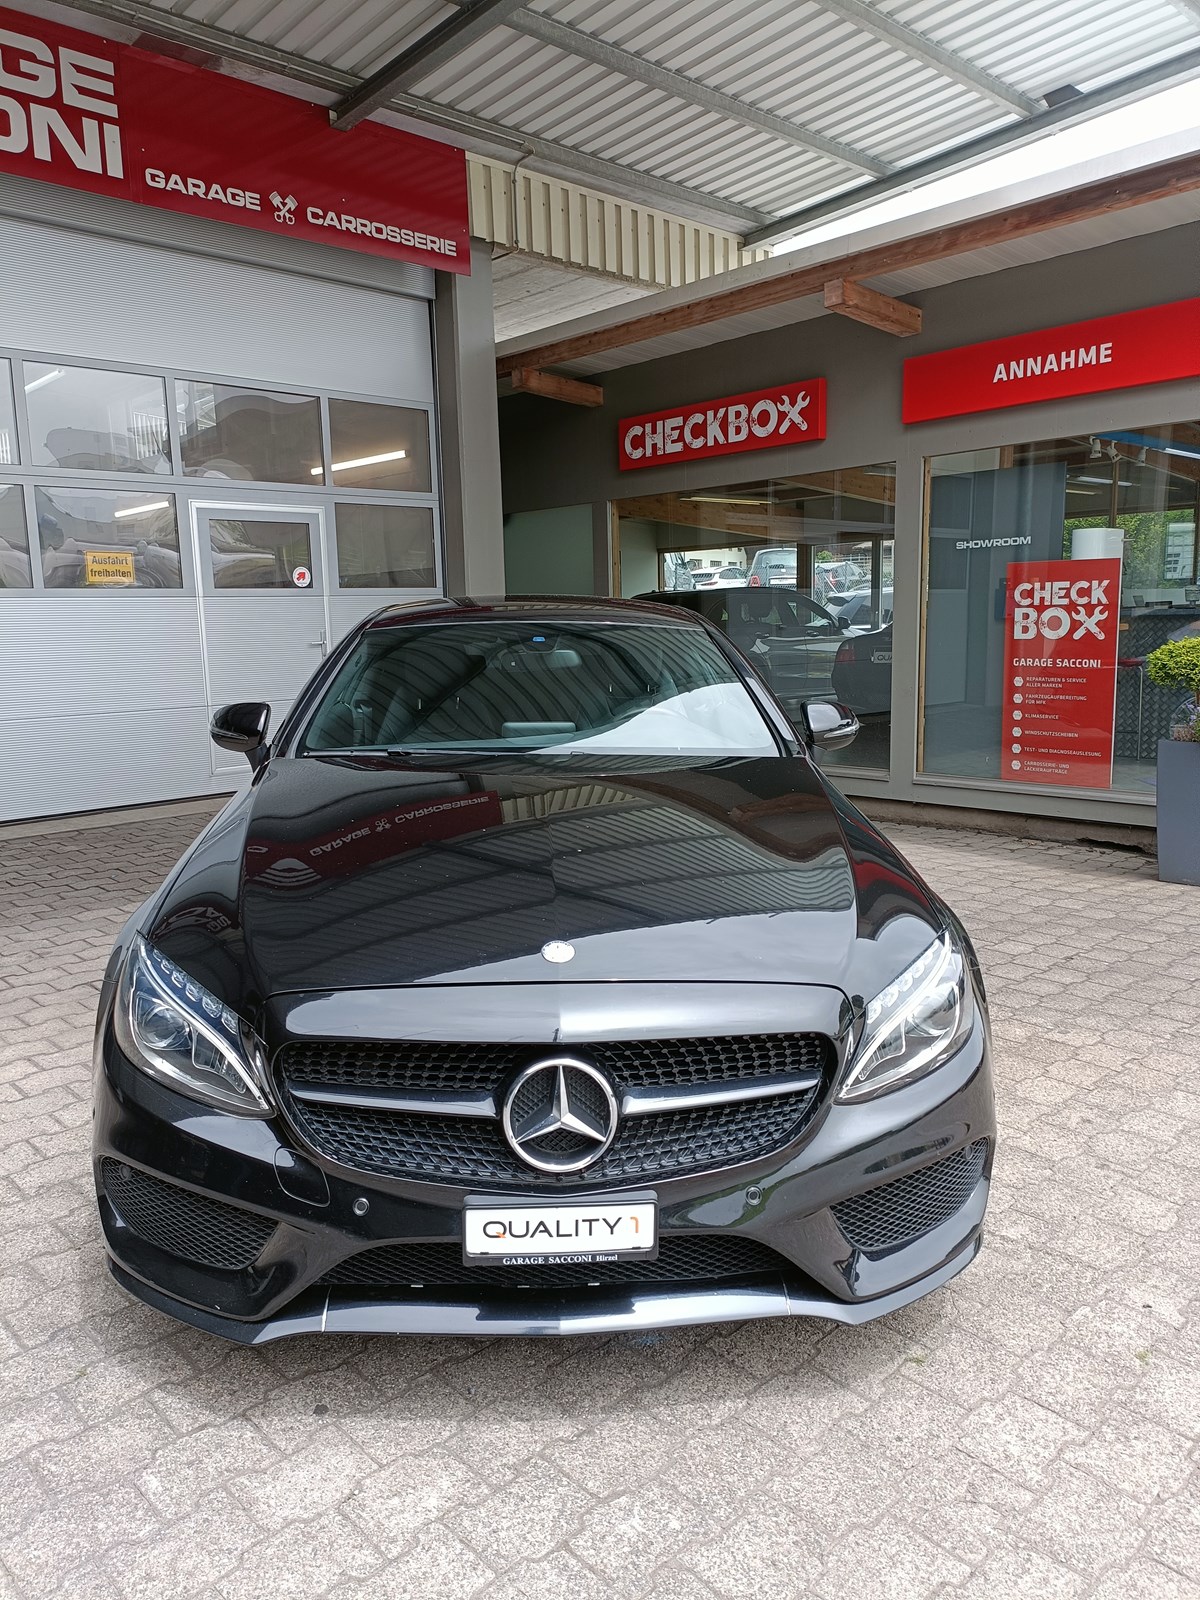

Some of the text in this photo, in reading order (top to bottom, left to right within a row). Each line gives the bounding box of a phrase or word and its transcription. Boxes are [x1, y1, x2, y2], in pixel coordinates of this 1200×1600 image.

[145, 168, 457, 257] GARAGE CARROSSERIE
[992, 342, 1113, 383] ANNAHME
[624, 390, 810, 460] CHECKBOX
[956, 536, 1031, 549] SHOWROOM
[92, 556, 128, 566] Ausfahrt
[90, 568, 132, 578] freihalten
[1014, 580, 1110, 606] CHECK
[1014, 606, 1109, 640] BOX
[1013, 658, 1101, 668] GARAGE SACCONI
[1049, 748, 1102, 757] DIAGNOSEAUSLESUNG
[503, 1257, 545, 1265] GARAGE
[549, 1255, 592, 1264] SACCONI
